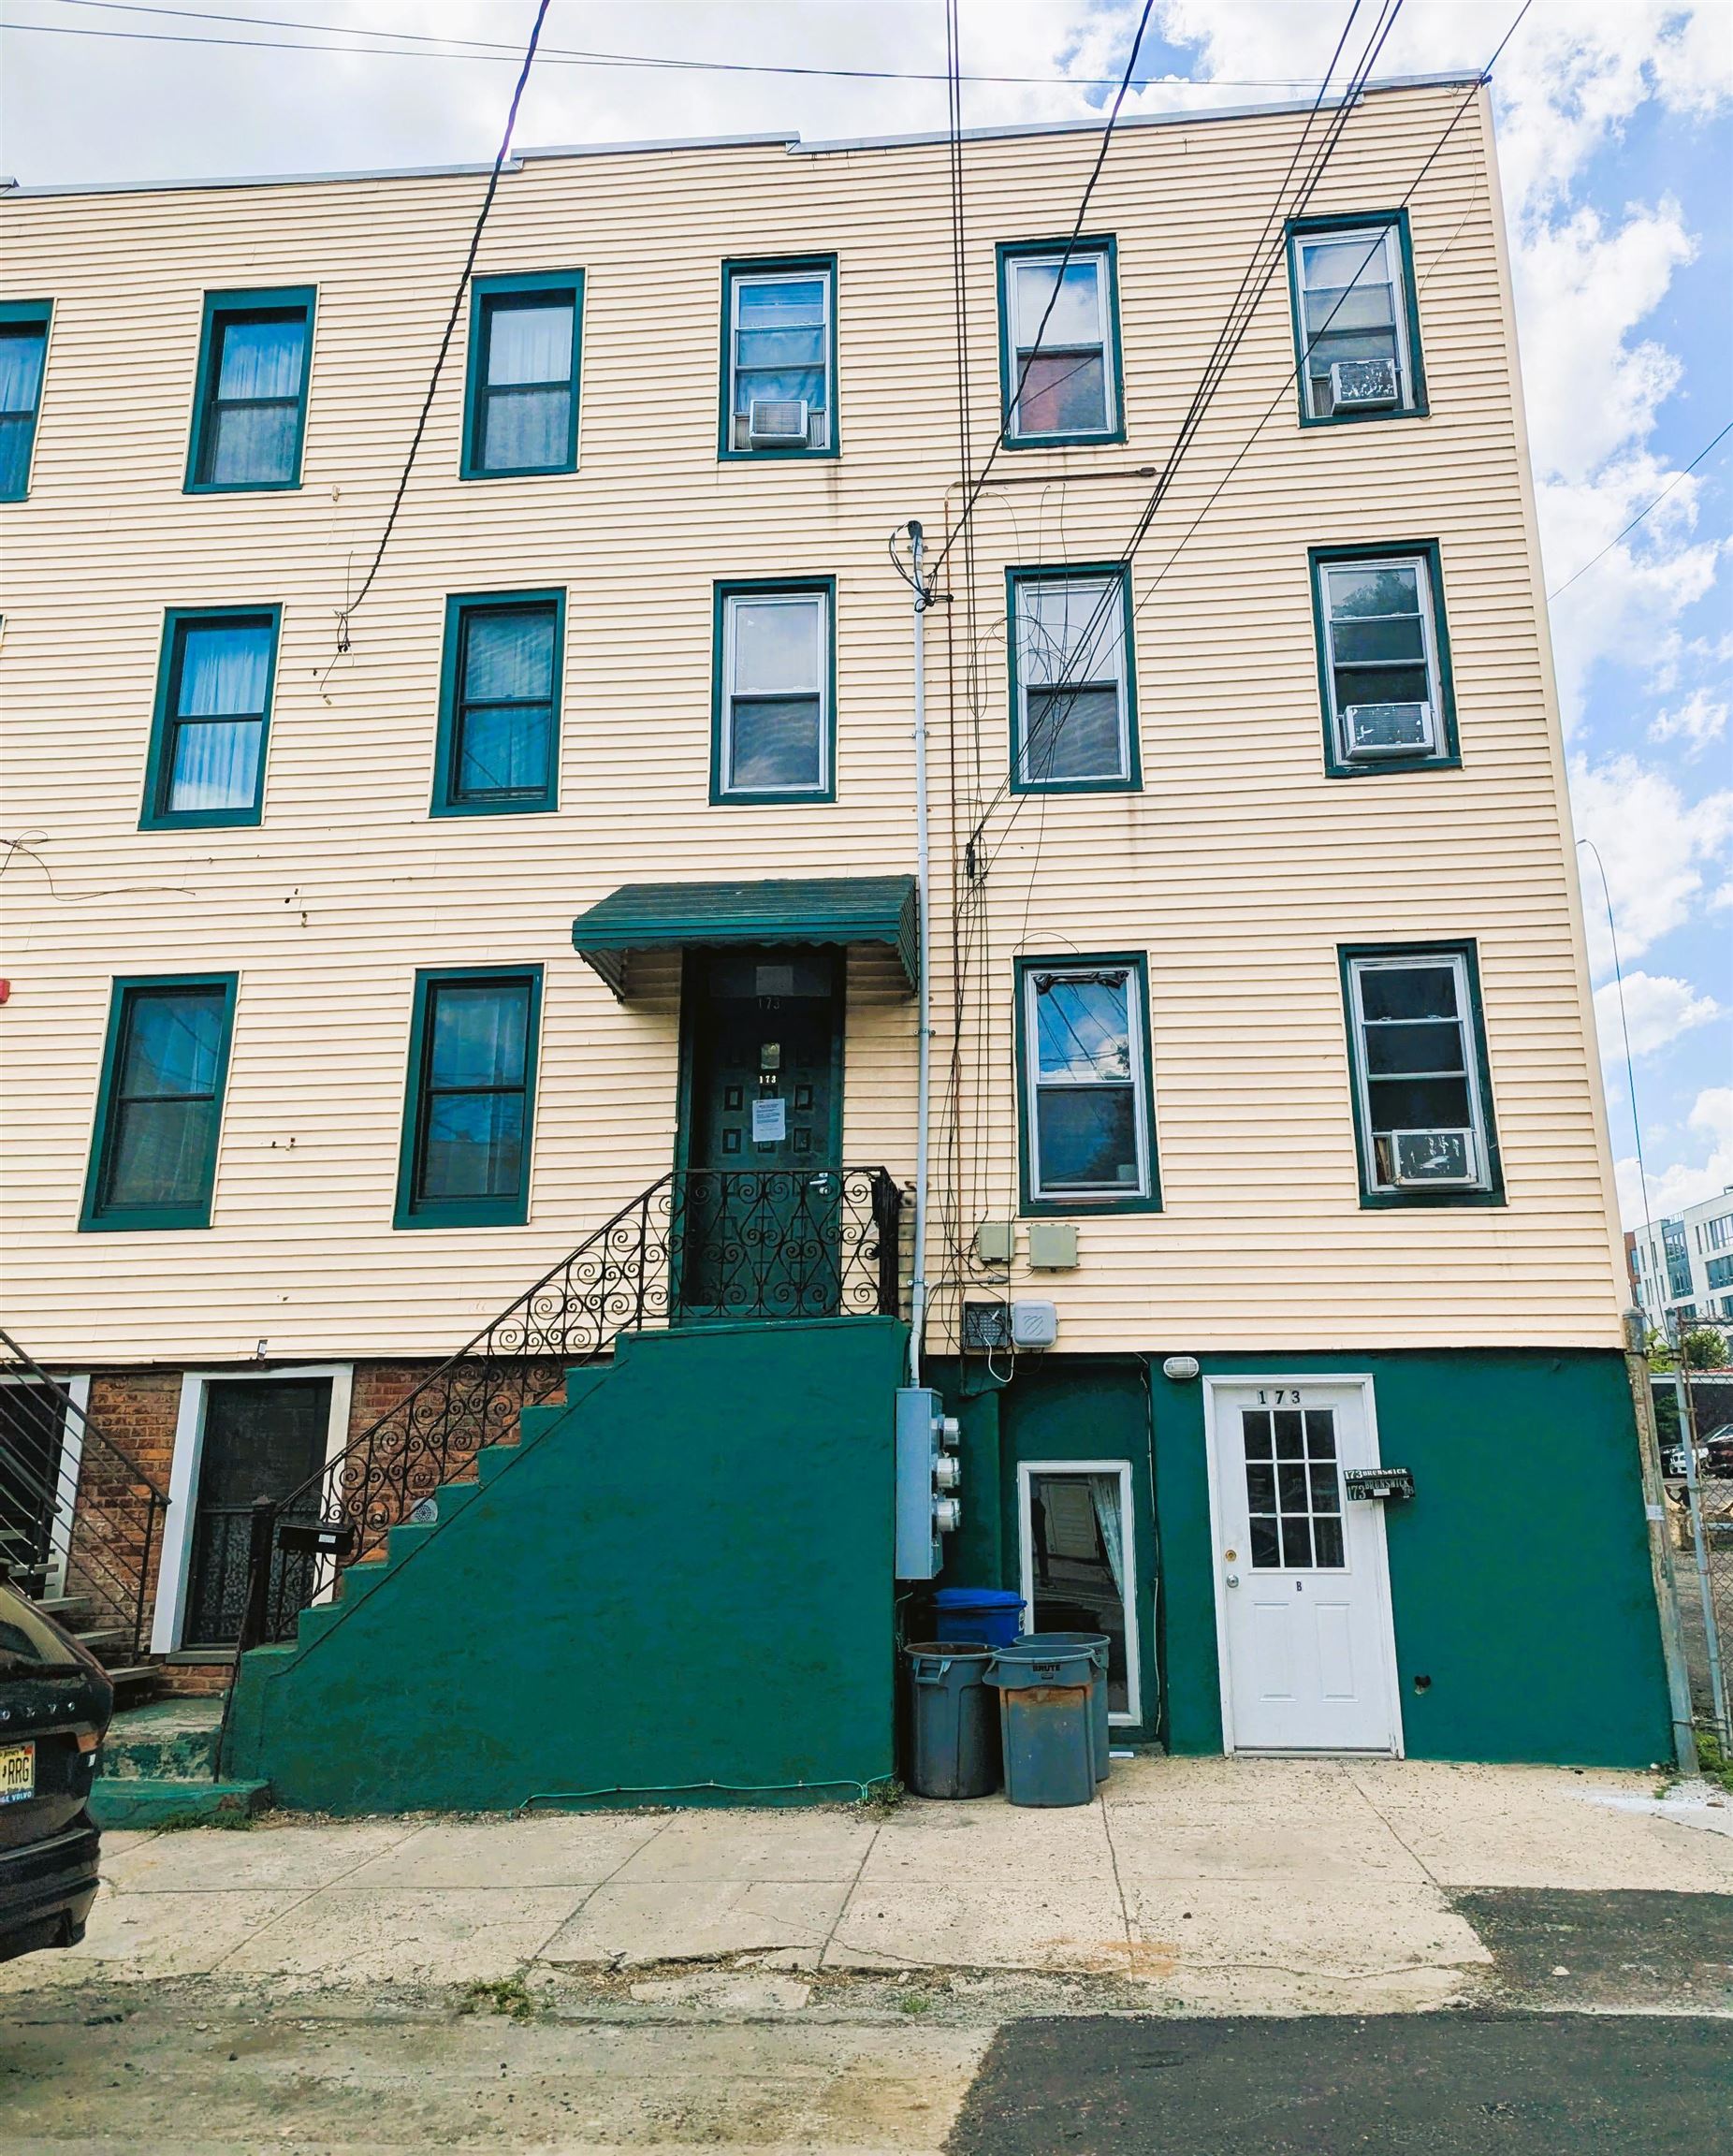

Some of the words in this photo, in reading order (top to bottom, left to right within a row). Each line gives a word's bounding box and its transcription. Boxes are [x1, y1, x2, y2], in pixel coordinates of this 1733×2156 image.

[759, 997, 780, 1010] 173
[759, 1075, 777, 1084] 173
[1258, 1390, 1301, 1405] 173
[1345, 1470, 1363, 1479] 173
[1347, 1484, 1366, 1500] 173
[1364, 1478, 1409, 1490] BRUNSWICK
[1296, 1581, 1303, 1592] B
